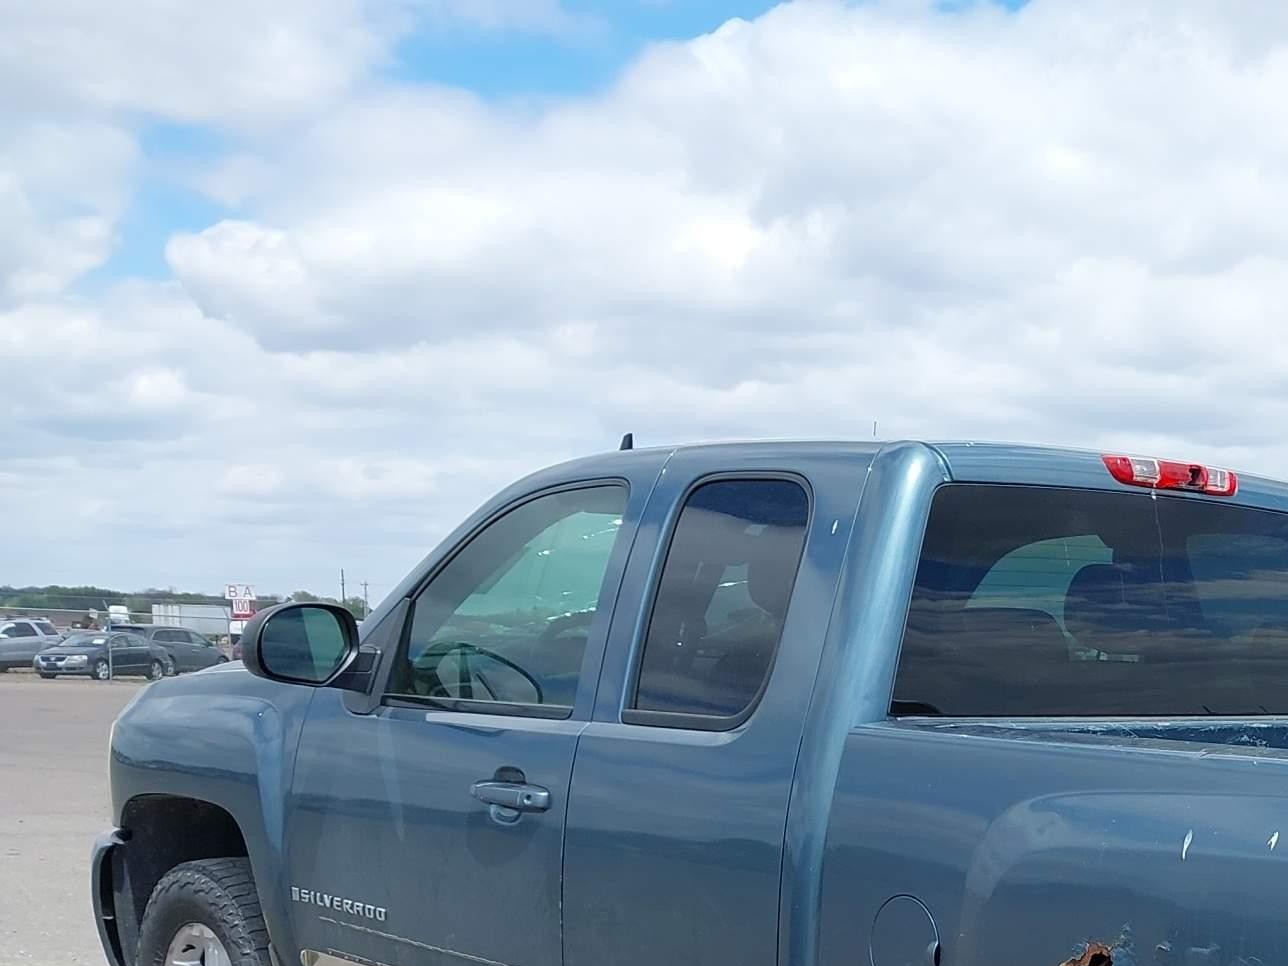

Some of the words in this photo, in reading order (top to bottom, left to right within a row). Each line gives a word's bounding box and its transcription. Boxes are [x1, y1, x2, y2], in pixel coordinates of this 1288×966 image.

[228, 585, 238, 598] B
[243, 586, 253, 598] A
[234, 600, 249, 612] 100
[300, 888, 387, 921] SILVERADO
